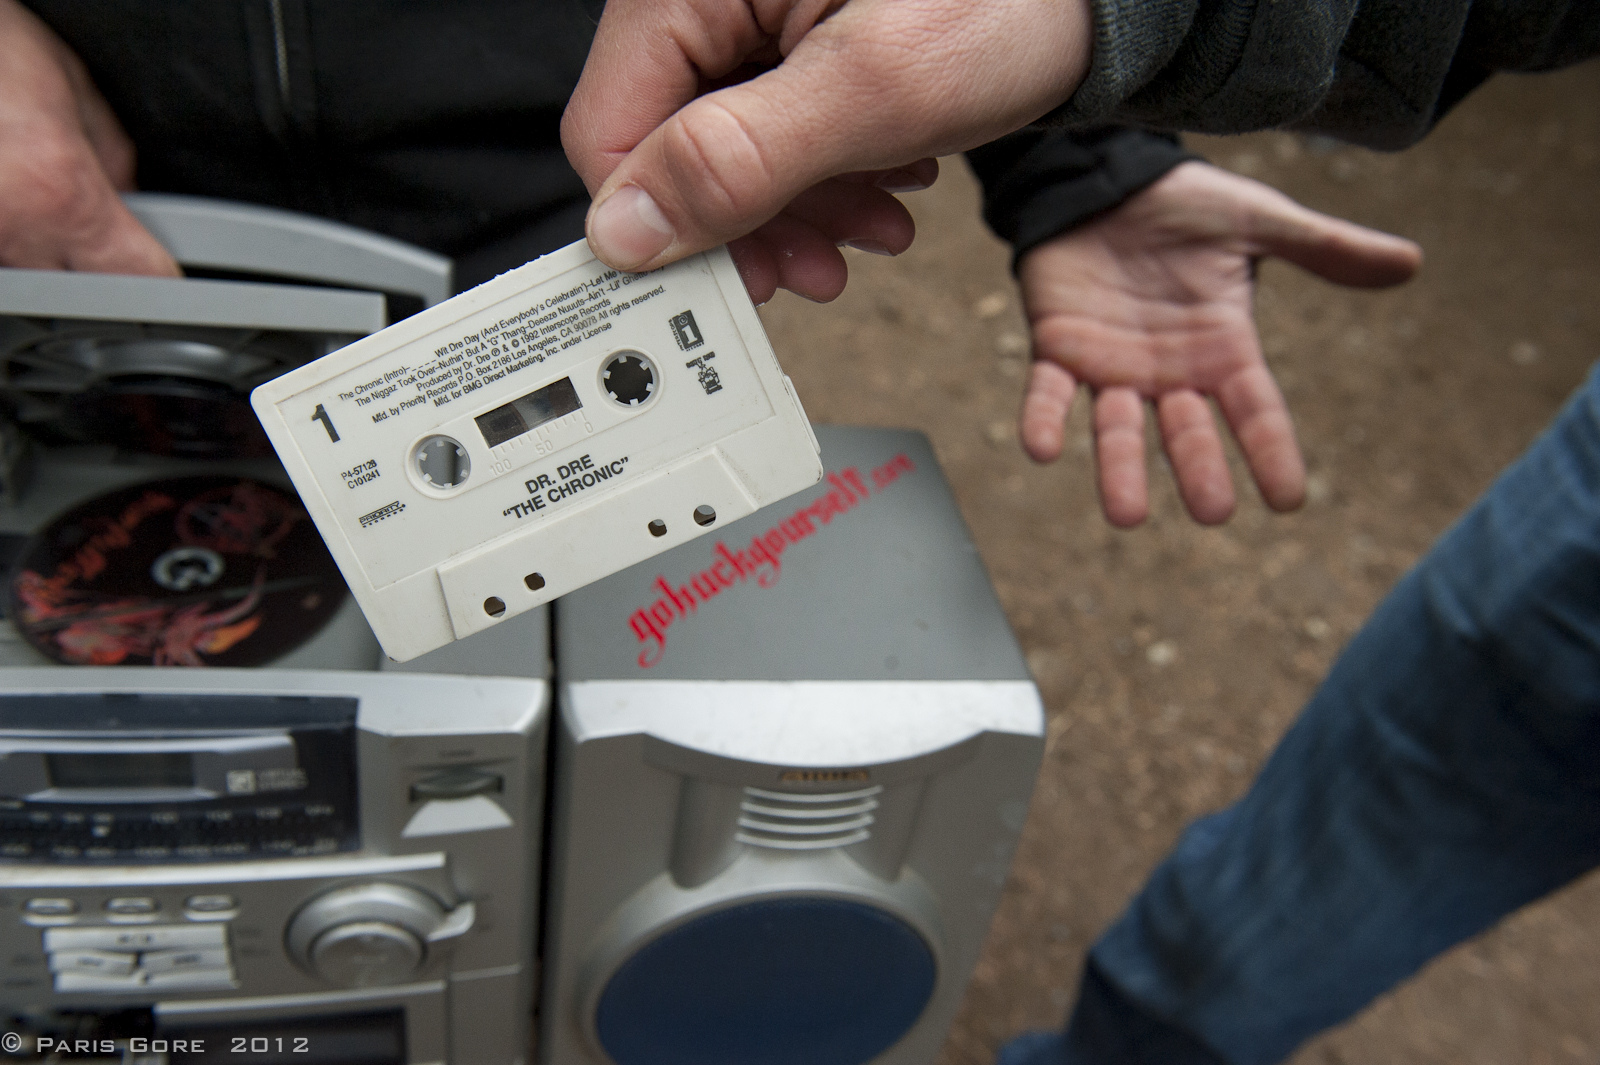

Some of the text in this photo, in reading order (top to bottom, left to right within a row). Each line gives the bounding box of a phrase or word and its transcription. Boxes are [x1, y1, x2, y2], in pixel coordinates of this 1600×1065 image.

[337, 391, 355, 401] The
[354, 377, 384, 395] Chronic
[434, 346, 449, 358] Wit
[448, 341, 464, 352] Dre
[463, 333, 480, 345] Day
[480, 323, 500, 340] (And
[498, 303, 545, 329] Everybody's
[604, 269, 617, 281] Me
[371, 284, 666, 424] Mfd. by Priority Records P.O. Box 2186 Los Angeles, CA 90078 All rights reserved.
[415, 369, 453, 392] Produced
[451, 365, 463, 375] by
[462, 360, 476, 371] Dr.
[475, 353, 491, 365] Dre
[501, 343, 510, 353] &
[520, 329, 540, 344] 1992
[539, 313, 579, 336] Interscope
[578, 298, 611, 318] Records
[433, 322, 612, 407] Mfd. for BMG Direct Marketing, Inc. under License
[354, 396, 372, 407] The
[370, 384, 398, 401] Niggaz
[396, 374, 418, 388] Took
[464, 345, 480, 358] But
[480, 341, 488, 351] A
[311, 403, 341, 443] 1
[340, 459, 377, 480] P4-57128
[347, 468, 381, 489] C101241
[524, 453, 595, 494] DR. DRE
